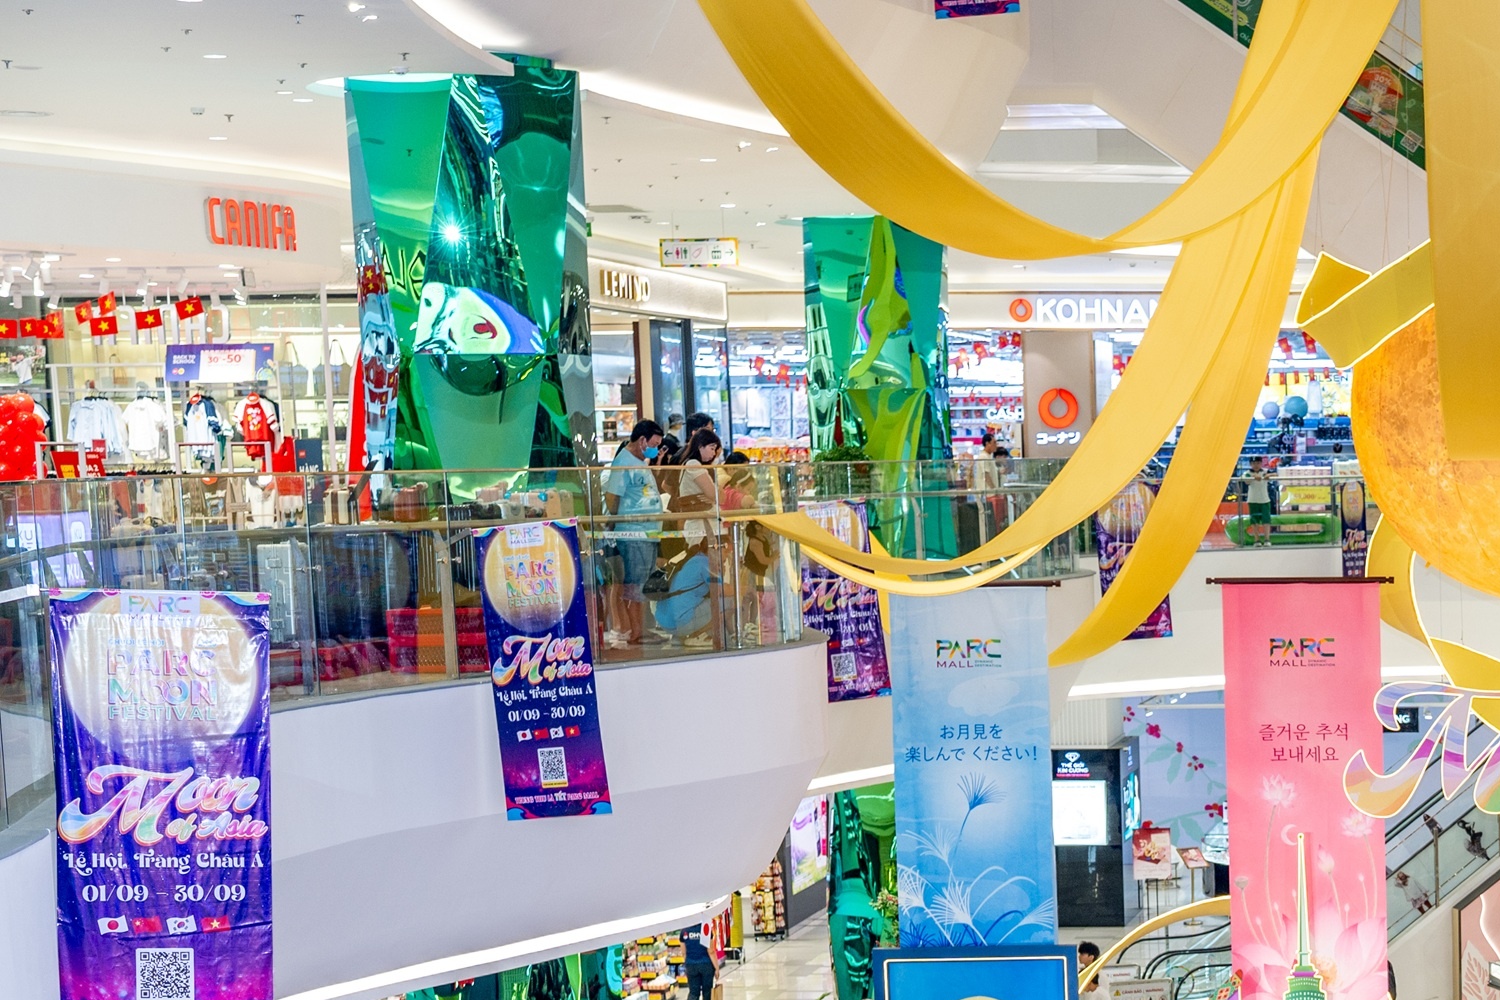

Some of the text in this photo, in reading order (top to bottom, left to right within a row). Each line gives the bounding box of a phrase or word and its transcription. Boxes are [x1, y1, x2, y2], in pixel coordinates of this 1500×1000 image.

[207, 197, 297, 251] CANIFA
[1036, 431, 1081, 445] コーナン
[509, 526, 540, 538] PARC
[503, 558, 555, 581] PARC
[505, 577, 558, 598] MOON
[128, 596, 193, 614] PARC
[507, 596, 559, 609] FESTIVAL
[936, 638, 1002, 659] PARC
[1269, 638, 1335, 657] PARC
[107, 650, 218, 677] PARC
[492, 632, 585, 687] Moon
[936, 660, 974, 668] MALL
[1269, 659, 1307, 667] MALL
[543, 662, 592, 682] of Asia
[107, 678, 218, 705] MOON
[108, 706, 218, 720] FESTIVAL
[508, 705, 585, 722] 01/09 30/09
[940, 724, 1003, 740] お月見を
[1258, 722, 1349, 741] 즐거운 추석
[905, 746, 966, 763] 楽しんで
[1270, 745, 1340, 764] 보내세요
[58, 764, 261, 847] Moon
[165, 811, 269, 844] of Asia
[63, 848, 264, 876] Lễ Hội Trăng Châu Á
[82, 884, 246, 903] 01/09 30/09
